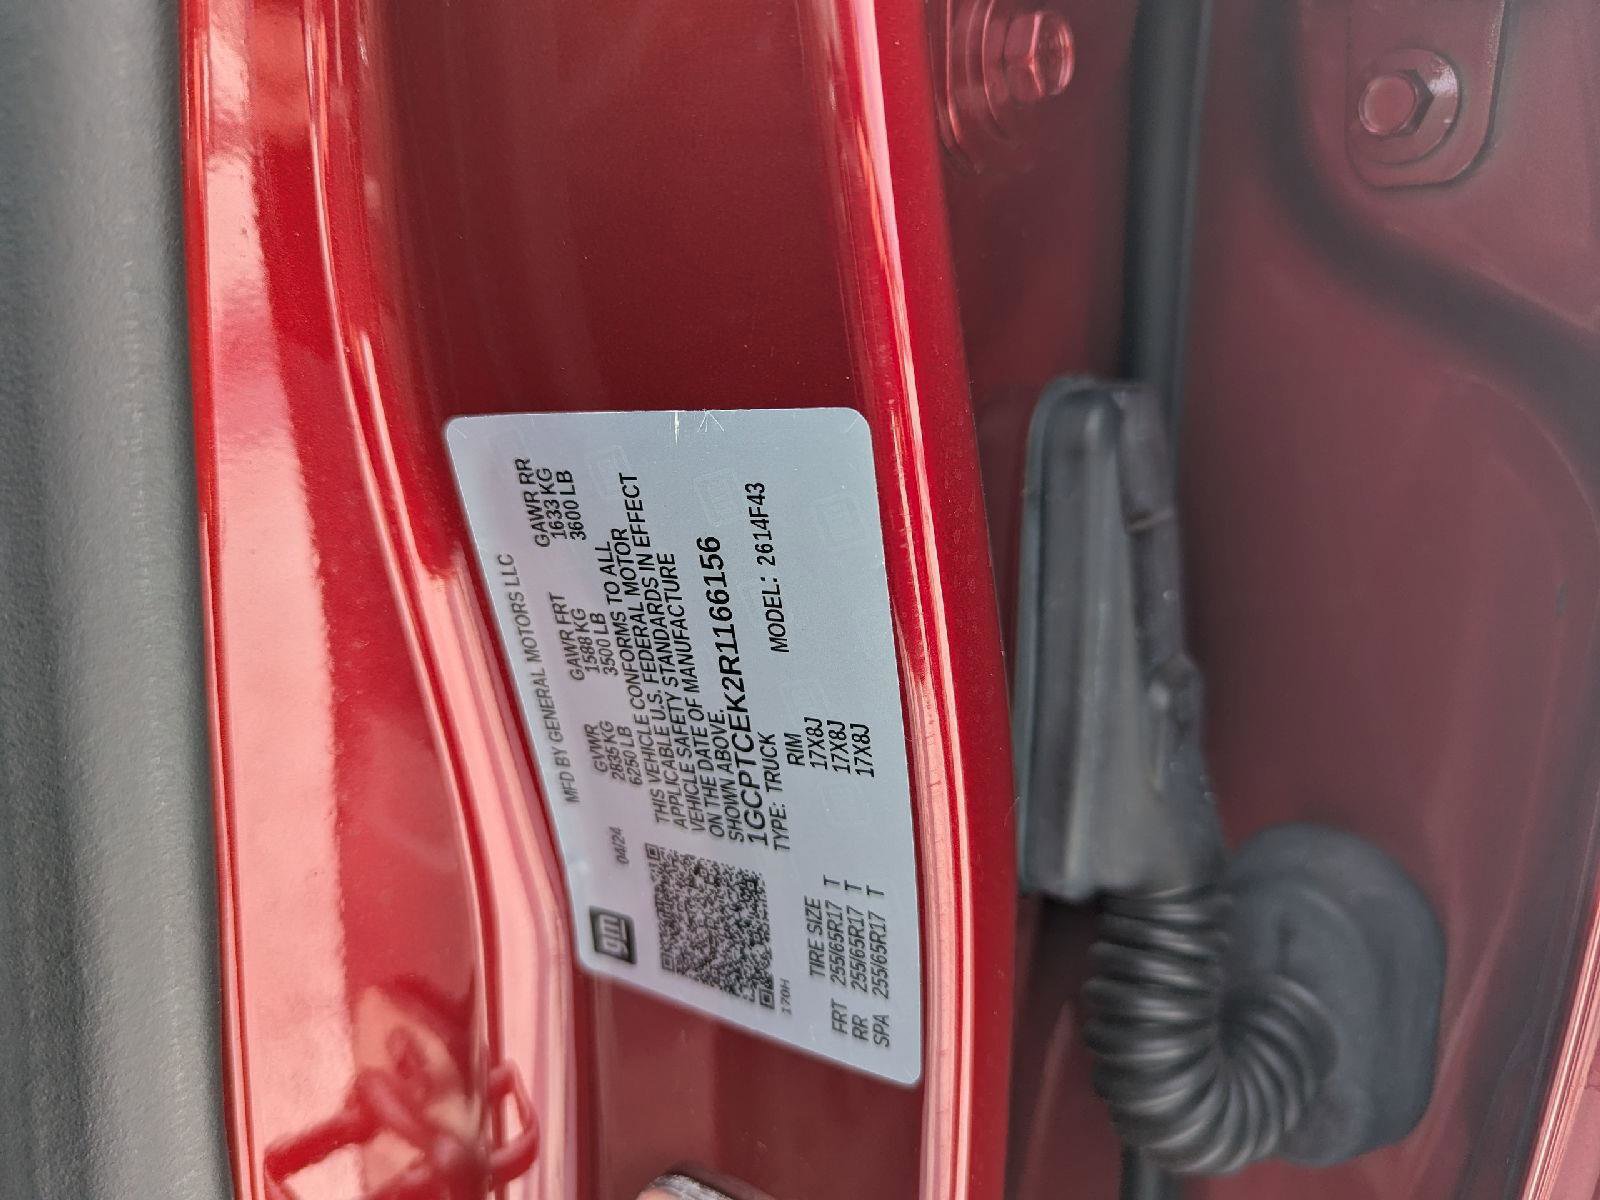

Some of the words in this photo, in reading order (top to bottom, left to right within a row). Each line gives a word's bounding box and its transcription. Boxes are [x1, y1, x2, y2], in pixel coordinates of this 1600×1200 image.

[515, 458, 536, 485] RR
[536, 467, 557, 495] KG
[556, 470, 577, 496] LB
[522, 491, 550, 547] GAWR
[544, 499, 567, 539] 1633
[562, 499, 587, 541] 3600
[619, 472, 651, 547] EFFECT
[745, 482, 776, 565] 2614F43
[497, 553, 520, 586] LLC
[595, 541, 618, 577] ALL
[610, 528, 639, 596] MOTOR
[637, 553, 654, 571] IN
[549, 592, 569, 625] FRT
[604, 581, 621, 605] TO
[508, 591, 540, 663] MOTORS
[570, 607, 590, 633] KG
[590, 612, 608, 635] LB
[642, 577, 679, 688] STANDARDS
[656, 553, 699, 692] MANUFACTURE
[759, 576, 789, 653] MODEL:
[559, 629, 585, 681] GAWR
[576, 636, 600, 673] 1588
[595, 639, 618, 676] 3500
[610, 611, 646, 710] CONFORMS
[628, 602, 659, 683] FEDERAL
[531, 668, 564, 743] GENERAL
[642, 689, 666, 720] U.S.
[683, 698, 705, 722] OF
[696, 535, 769, 847] 1GCPTCEK2R1166156
[599, 721, 615, 745] KG
[617, 726, 634, 748] LB
[664, 691, 691, 759] SAFETY
[709, 709, 734, 773] ABOVE.
[804, 717, 828, 770] 17X8J
[552, 746, 568, 766] BY
[584, 724, 608, 772] GVWR
[606, 746, 626, 781] 2835
[634, 715, 663, 783] VEHICLE
[690, 726, 713, 771] DATE
[758, 731, 783, 792] TRUCK
[784, 732, 806, 766] RIM
[827, 719, 851, 773] 17X8J
[850, 722, 874, 778] 17X8J
[559, 771, 581, 802] MFD
[624, 751, 642, 786] 6250
[653, 726, 688, 829] APPLICABLE
[648, 789, 670, 823] THIS
[678, 764, 705, 832] VEHICLE
[700, 776, 720, 808] THE
[722, 779, 744, 842] SHOWN
[706, 814, 724, 838] ON
[771, 802, 790, 852] TYPE:
[609, 827, 629, 865] 04/24
[823, 874, 841, 887] T
[844, 880, 862, 891] T
[866, 884, 884, 896] T
[804, 895, 823, 936] SIZE
[808, 941, 825, 978] TIRE
[825, 899, 846, 986] 255/65R17
[846, 904, 868, 993] 255/65R17
[868, 910, 889, 999] 255/65R17
[831, 998, 848, 1034] FRT
[852, 1015, 869, 1041] RR
[873, 1014, 890, 1048] SPA
